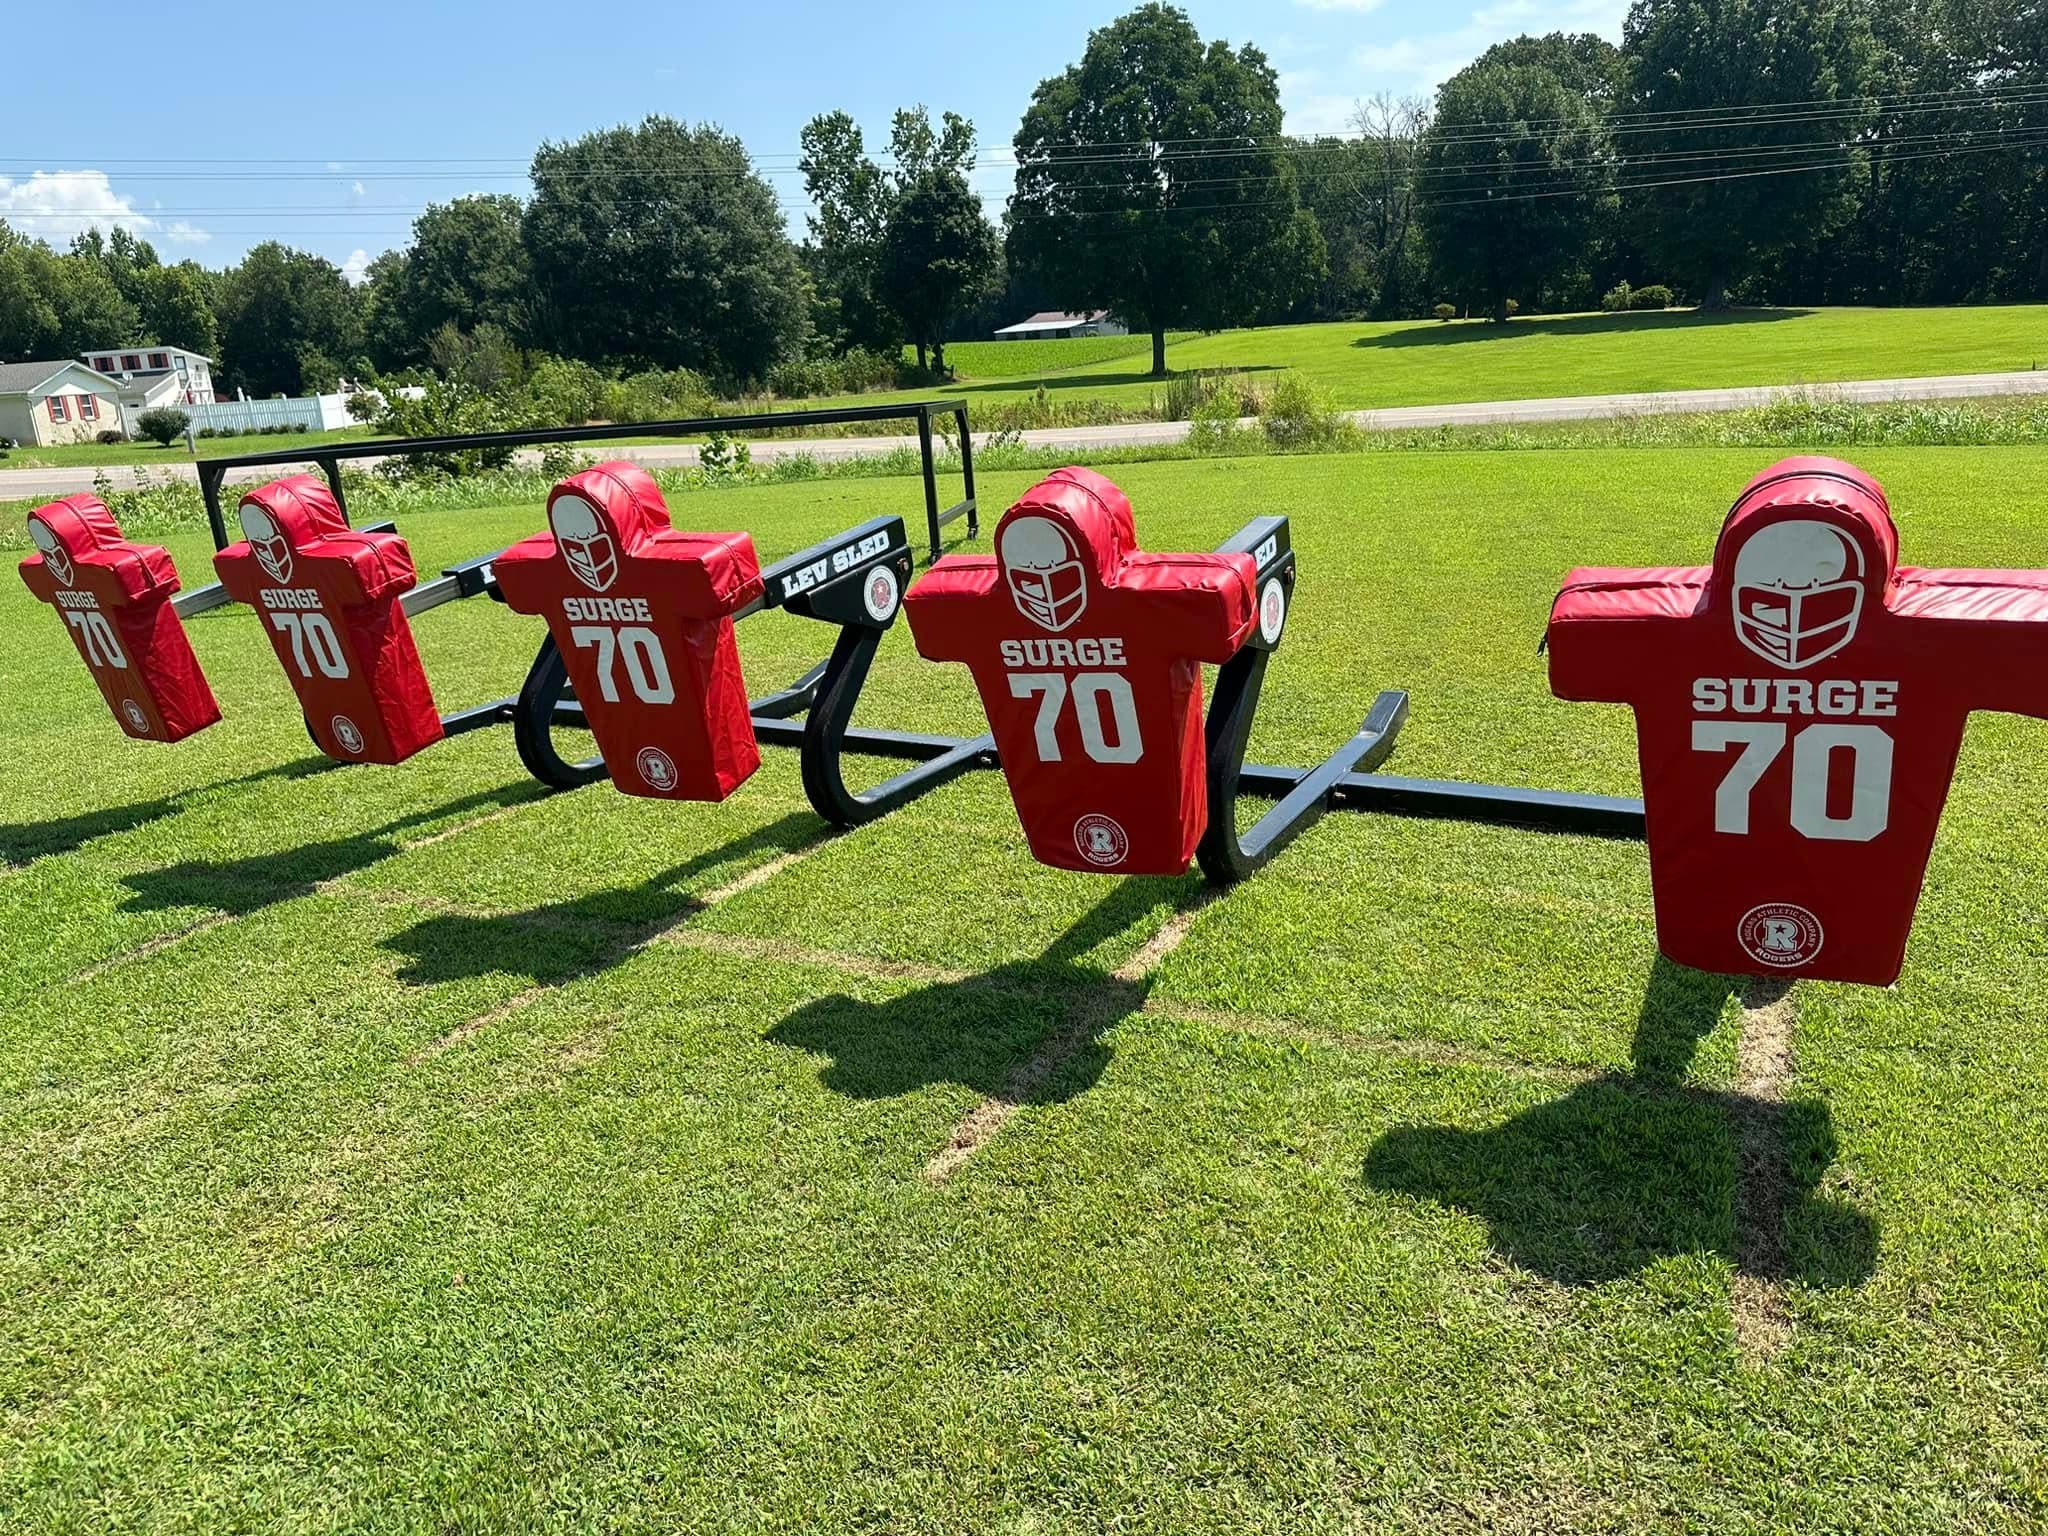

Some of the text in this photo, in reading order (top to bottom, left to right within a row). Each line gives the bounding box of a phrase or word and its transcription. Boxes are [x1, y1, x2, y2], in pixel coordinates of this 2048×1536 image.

[781, 558, 828, 599] LEV
[832, 530, 890, 573] SLED
[56, 591, 99, 608] SURGE
[261, 589, 322, 608] SURGE
[563, 598, 652, 622] SURGE
[66, 612, 127, 669] 70
[271, 613, 349, 679] 70
[1000, 638, 1127, 666] SURGE
[570, 626, 675, 704] 70
[1693, 678, 1898, 716] SURGE
[1007, 673, 1143, 763] 70
[1692, 721, 1894, 841] 70
[1087, 826, 1114, 853] R
[1757, 908, 1799, 919] ATHLETIC
[1799, 915, 1817, 948] COMPANY
[1762, 917, 1797, 951] R
[1755, 947, 1803, 962] ROGERS
